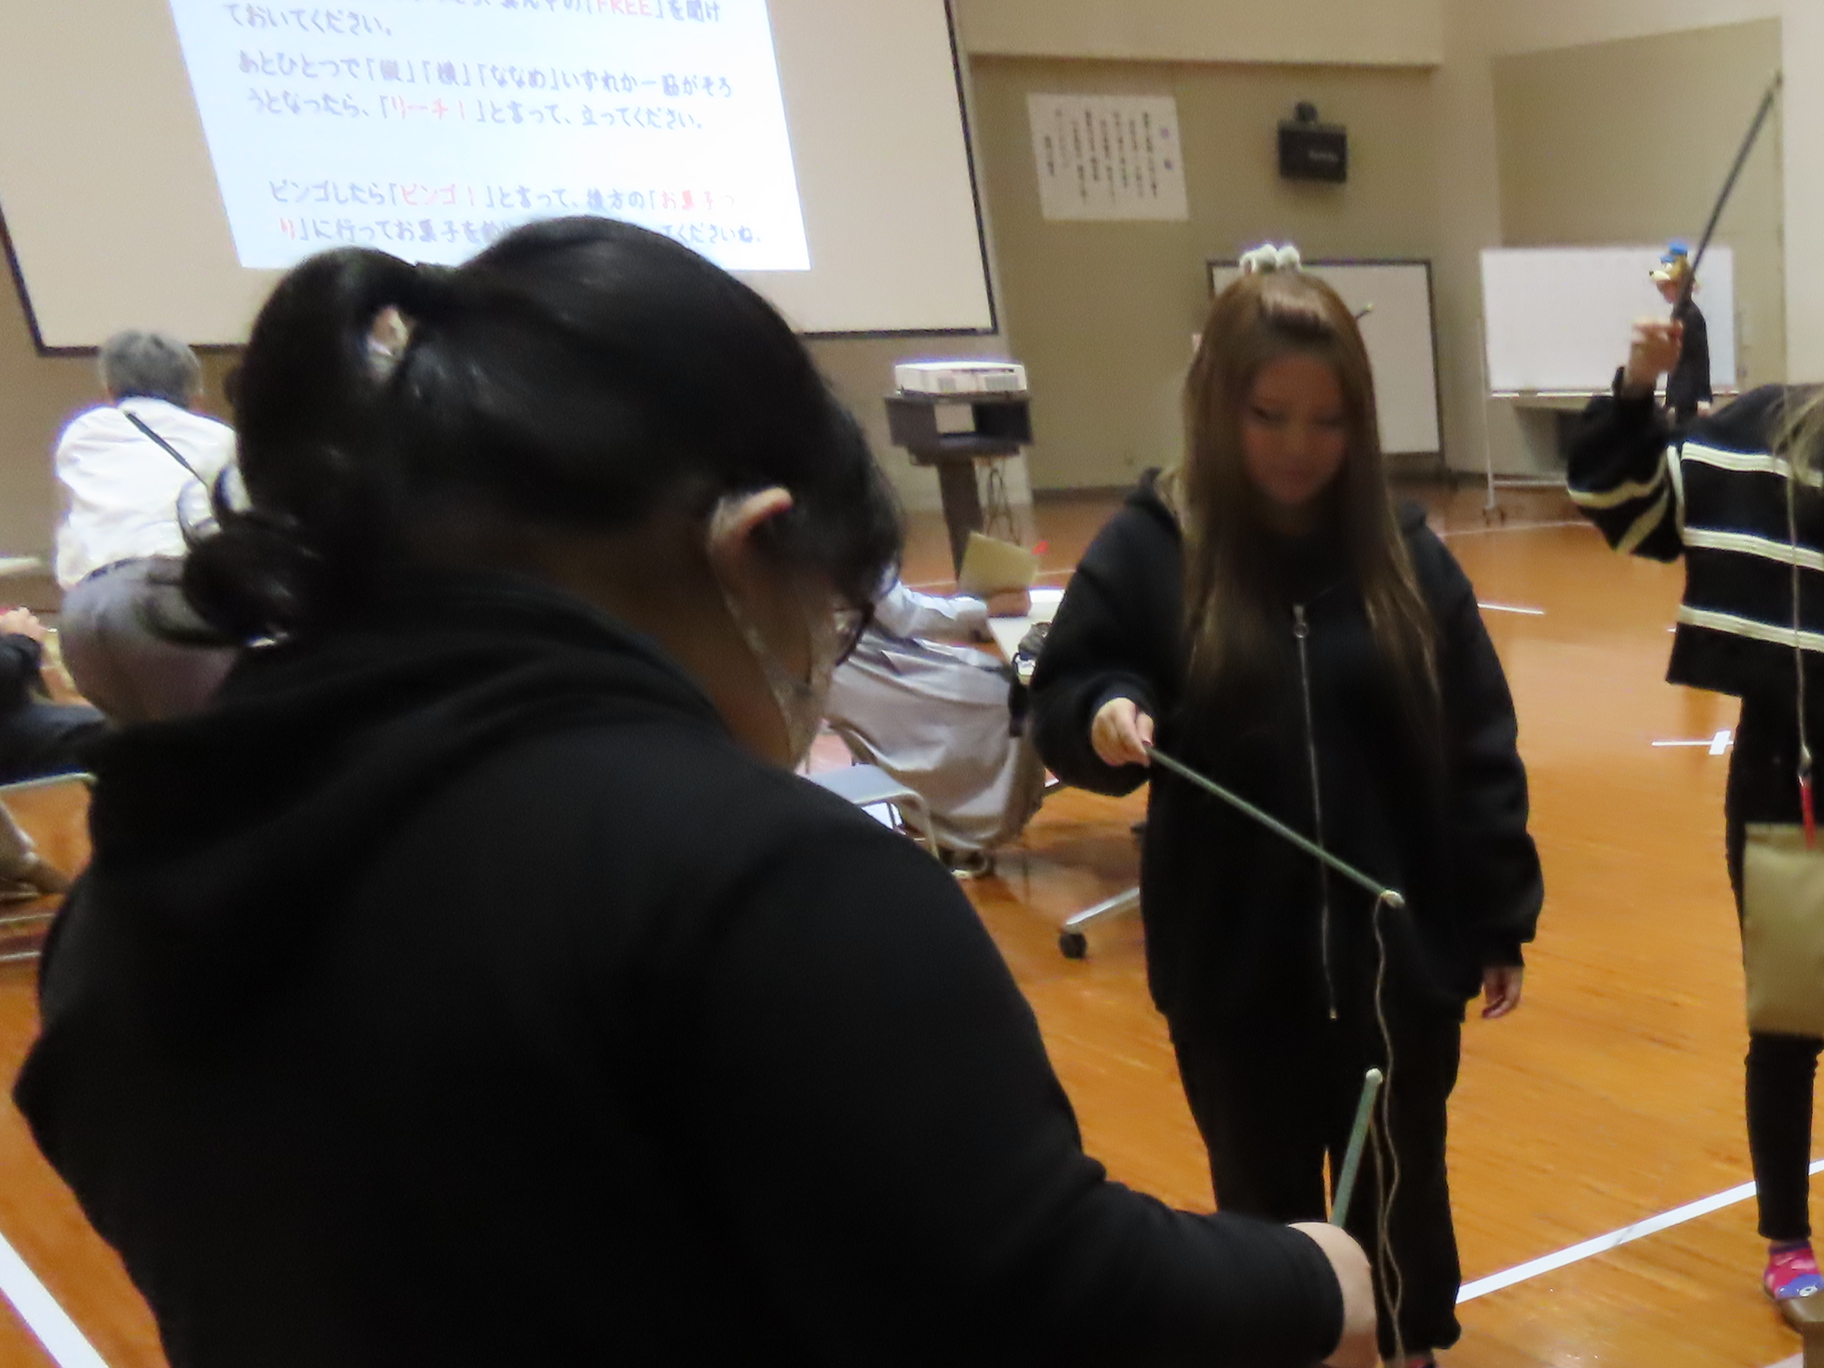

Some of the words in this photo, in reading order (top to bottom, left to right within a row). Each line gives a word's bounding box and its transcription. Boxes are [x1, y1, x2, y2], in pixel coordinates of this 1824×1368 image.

[222, 3, 393, 37] ておいてください。
